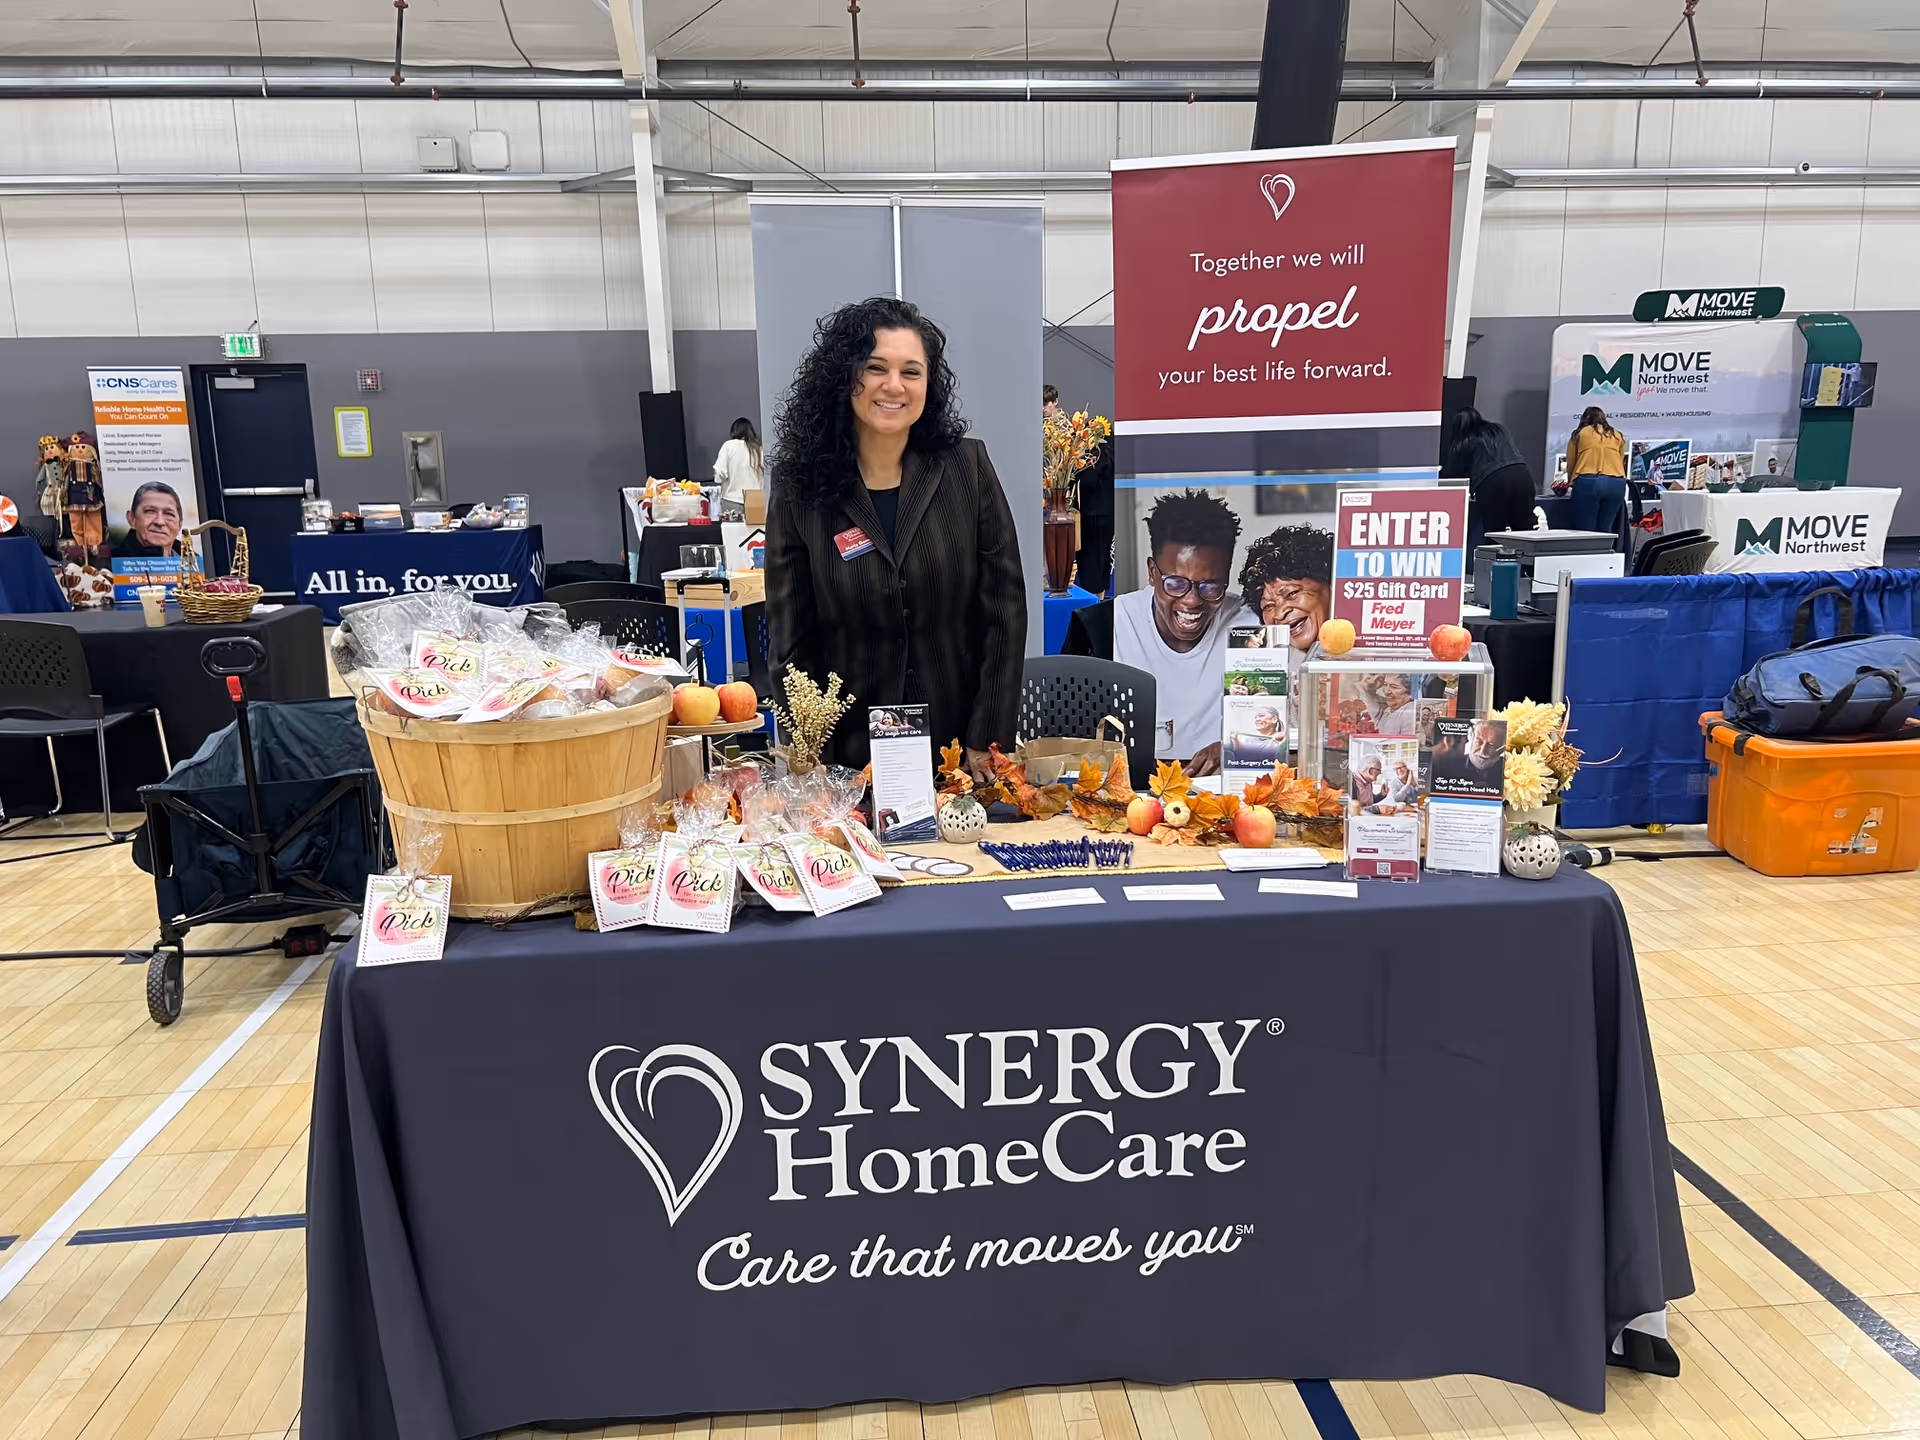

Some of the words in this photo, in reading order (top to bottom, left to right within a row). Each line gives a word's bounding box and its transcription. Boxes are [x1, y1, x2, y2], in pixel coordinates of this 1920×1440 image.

[1190, 250, 1285, 277] Together
[1293, 253, 1322, 268] we
[1330, 244, 1364, 265] will
[1700, 291, 1757, 308] MOVE
[1187, 285, 1359, 351] propel
[1697, 308, 1752, 317] Northwest
[1158, 368, 1205, 389] your
[1213, 364, 1257, 383] best
[1265, 361, 1296, 381] life
[1303, 357, 1392, 379] forward.
[1639, 351, 1711, 372] MOVE
[106, 378, 177, 388] CNSCares
[1639, 373, 1709, 384] Northwest
[1660, 449, 1687, 465] MOVE
[1351, 511, 1450, 546] ENTER
[1787, 515, 1869, 539] MOVE
[1785, 540, 1866, 554] Northwest
[1354, 552, 1385, 577] TO
[1390, 552, 1442, 577] WIN
[304, 570, 351, 594] All
[356, 569, 395, 596] in,
[402, 569, 448, 592] for
[452, 572, 517, 594] you.
[1344, 581, 1374, 599] $25
[1378, 582, 1406, 598] Gift
[1409, 582, 1448, 598] Card
[1371, 603, 1405, 614] Fred
[1370, 617, 1414, 632] Meyer
[424, 654, 473, 672] Pick
[401, 684, 449, 700] Pick
[607, 865, 654, 893] Pick
[811, 853, 852, 882] Pick
[672, 870, 724, 894] Pick
[758, 870, 794, 891] Pick
[379, 911, 436, 936] Pick
[760, 1019, 1261, 1120] SYNERGY
[763, 1110, 1247, 1201] HomeCare
[697, 1232, 838, 1292] Care
[850, 1234, 955, 1278] that
[965, 1228, 1132, 1271] moves
[1139, 1225, 1242, 1276] you
